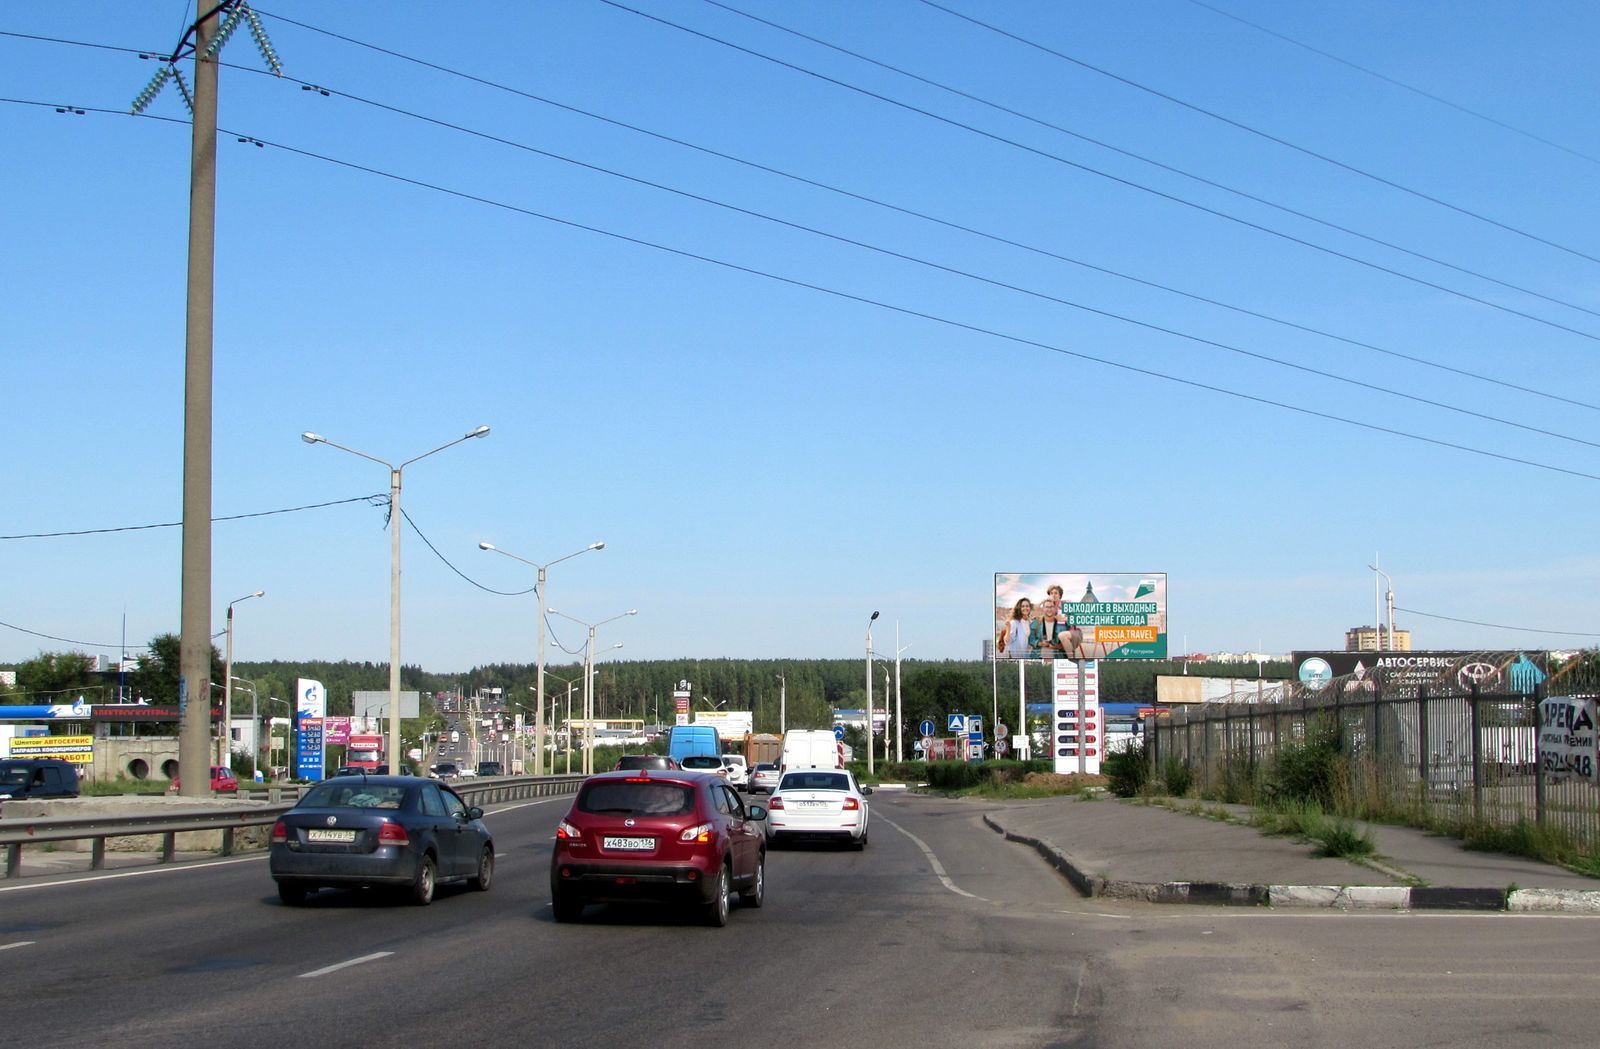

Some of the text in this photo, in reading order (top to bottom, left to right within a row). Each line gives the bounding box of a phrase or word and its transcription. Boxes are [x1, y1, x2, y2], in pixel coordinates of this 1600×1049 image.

[1063, 603, 1156, 614] ВЫХОДИТЕ В ВЫХОДНЫЕ
[1069, 615, 1145, 626] В СОСЕДНИЕ ГОРОДА
[1098, 630, 1153, 639] RUSSIA.TRAVEL
[1376, 657, 1455, 667] АВТОСЕРВИС
